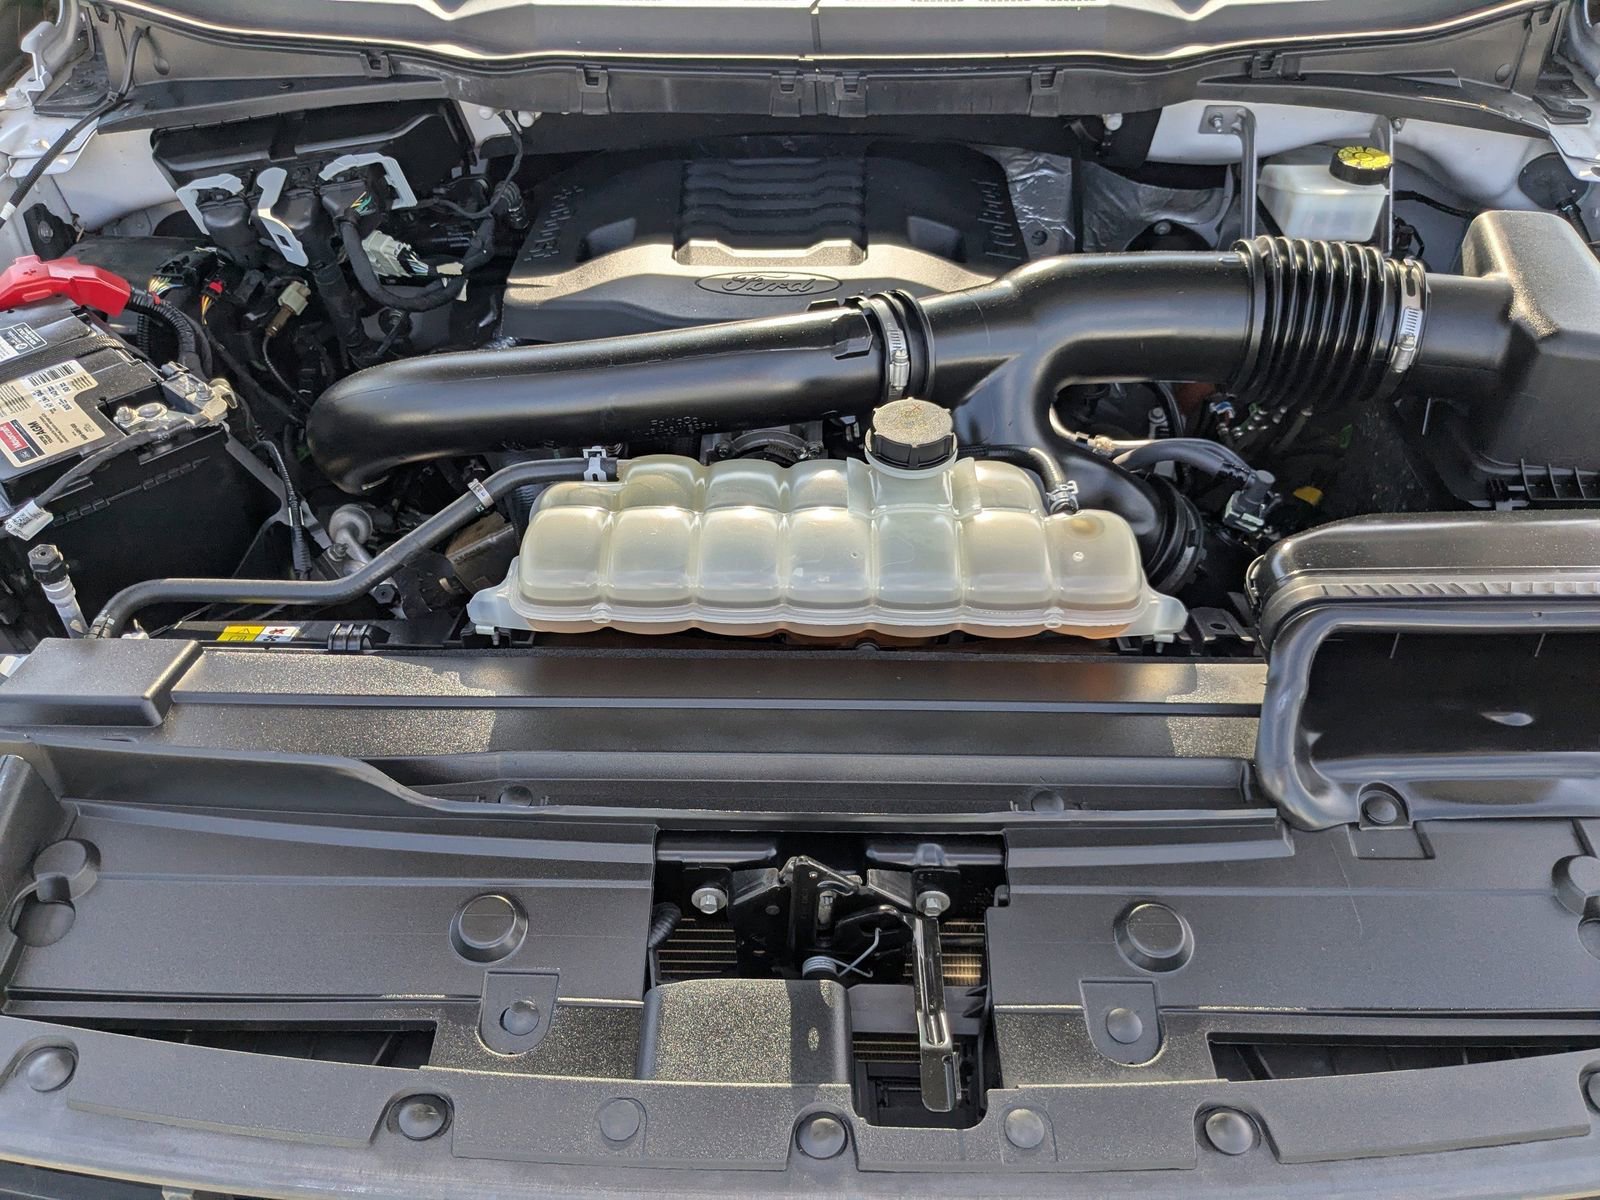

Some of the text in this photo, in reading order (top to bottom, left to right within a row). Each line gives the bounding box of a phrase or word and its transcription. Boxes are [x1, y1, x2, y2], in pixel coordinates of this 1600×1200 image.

[722, 273, 816, 292] Ford
[1, 425, 22, 449] Motorcraft
[27, 421, 46, 437] AGM
